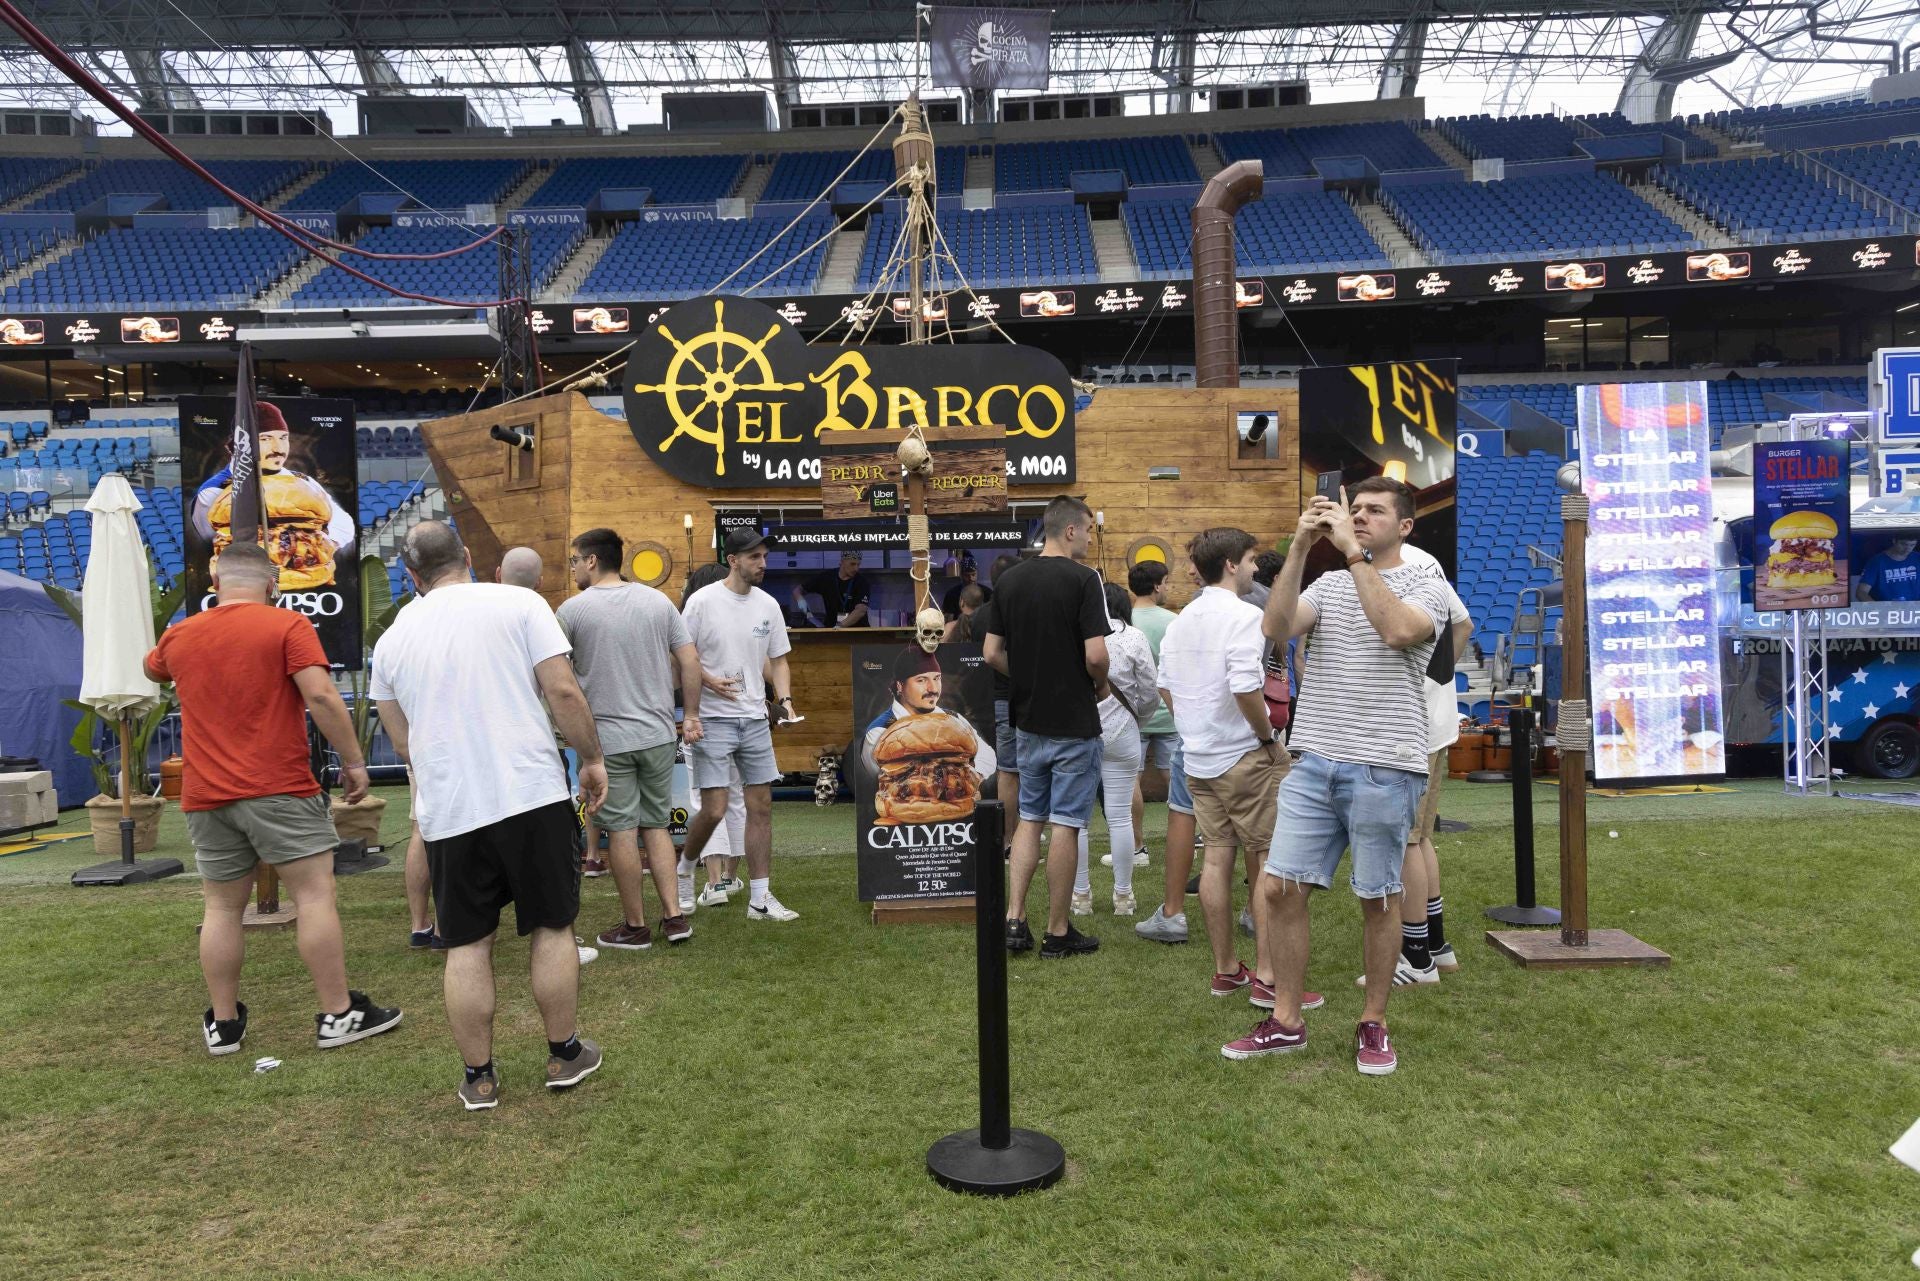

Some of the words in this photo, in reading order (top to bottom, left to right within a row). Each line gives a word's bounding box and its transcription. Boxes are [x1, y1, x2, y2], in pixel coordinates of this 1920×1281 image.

[993, 23, 1004, 34] LA
[992, 36, 1028, 46] COCINA
[992, 50, 1031, 66] PIRATA
[529, 214, 580, 224] YASUDA
[662, 211, 714, 222] YASUDA
[1786, 249, 1800, 260] The
[1852, 251, 1892, 262] Champions
[1866, 244, 1880, 254] The
[1772, 256, 1812, 267] Champions
[1778, 264, 1806, 274] Burger
[1858, 259, 1886, 268] Burger
[735, 402, 802, 443] EL
[1402, 423, 1424, 462] by
[1629, 428, 1660, 442] LA
[1594, 451, 1697, 467] STELLAR
[1768, 450, 1800, 458] BURGER
[742, 450, 760, 469] by
[765, 458, 792, 480] LA
[1021, 455, 1066, 476] MOA
[830, 464, 888, 481] PEDIR
[1766, 454, 1840, 480] STELLAR
[931, 474, 1005, 492] RECOGER
[1594, 479, 1699, 495] STELLAR
[851, 484, 865, 500] Y
[874, 490, 894, 498] Uber
[874, 498, 895, 506] Eats
[1596, 504, 1700, 520] STELLAR
[721, 518, 757, 526] RECOGE
[790, 534, 837, 544] BURGER
[838, 532, 862, 543] MÁS
[936, 532, 950, 540] DE
[954, 532, 974, 540] LOS
[976, 532, 982, 540] 7
[984, 531, 1022, 542] MARES
[1598, 531, 1702, 546] STELLAR
[1599, 556, 1703, 572] STELLAR
[1600, 583, 1704, 598] STELLAR
[1601, 608, 1705, 624] STELLAR
[1602, 634, 1706, 650] STELLAR
[1733, 638, 1782, 654] FROM
[1868, 638, 1893, 650] TO
[1604, 660, 1708, 676] STELLAR
[1605, 684, 1708, 700] STELLAR
